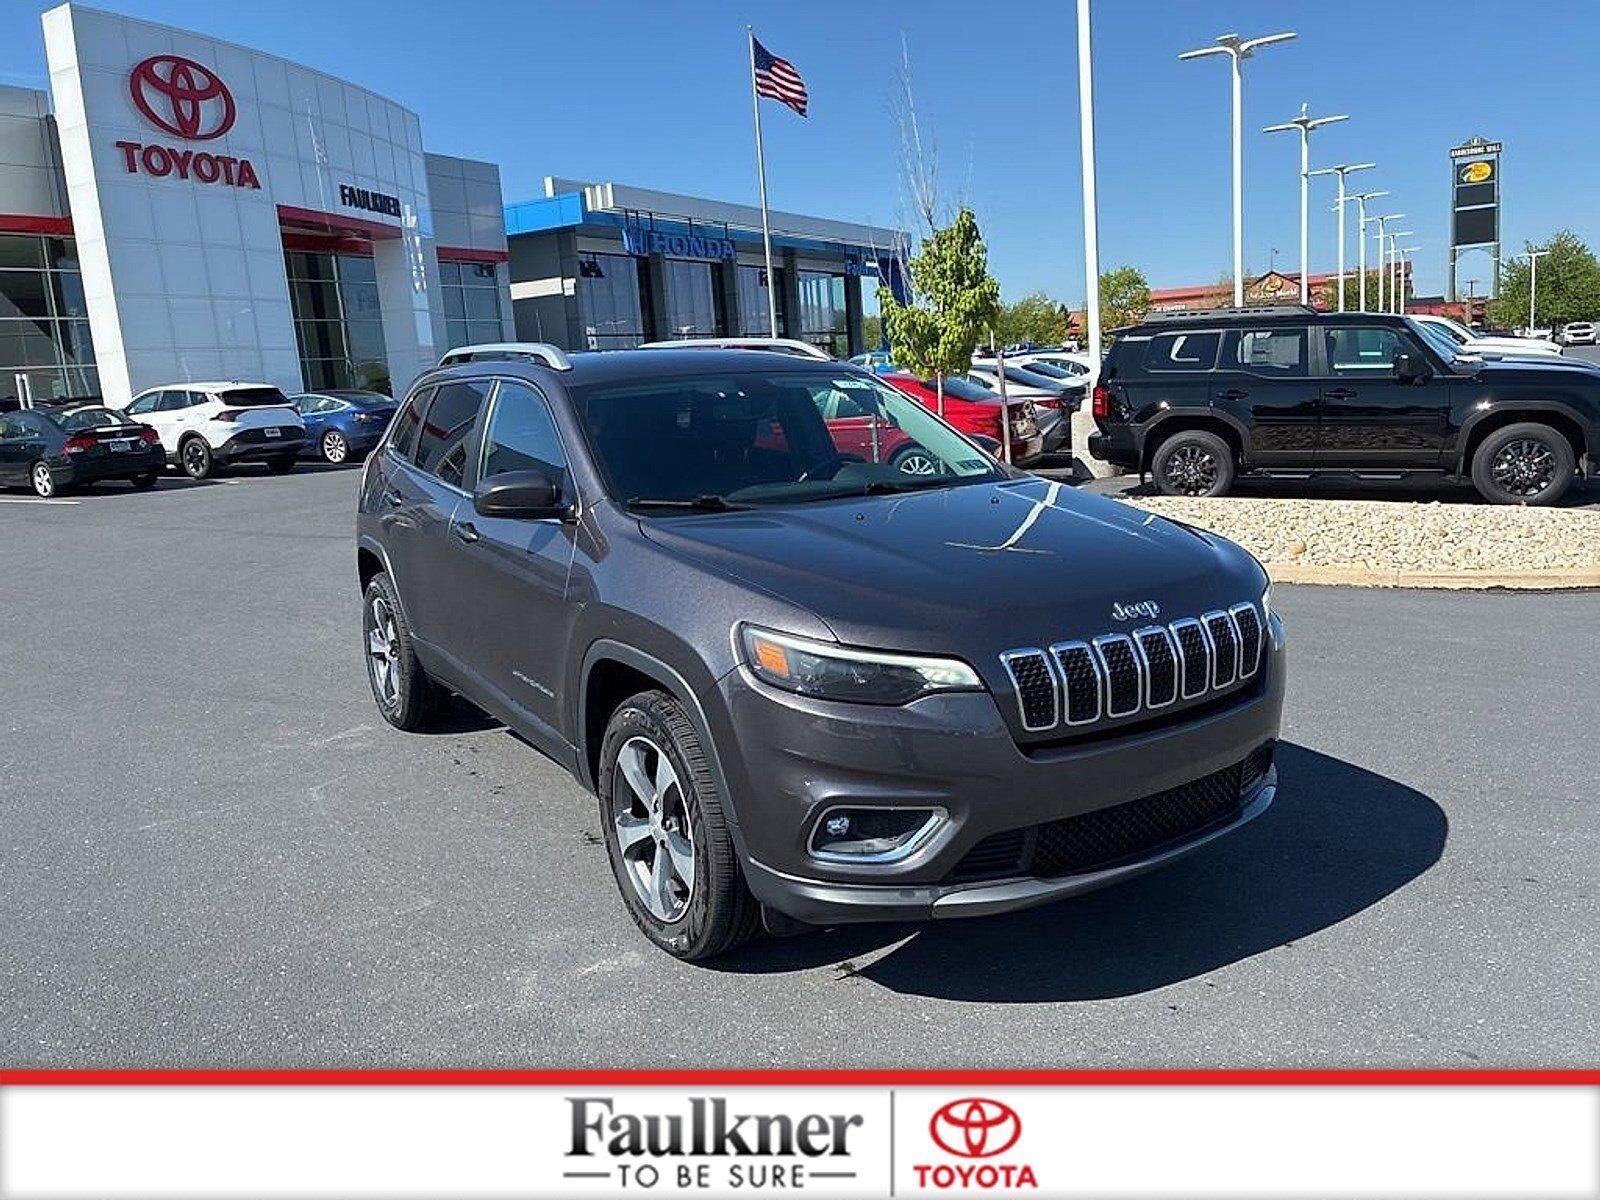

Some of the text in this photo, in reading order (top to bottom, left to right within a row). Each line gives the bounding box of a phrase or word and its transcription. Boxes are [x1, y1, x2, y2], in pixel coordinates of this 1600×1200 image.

[115, 140, 261, 189] TOYOTA
[339, 184, 402, 218] FAULKNER
[649, 233, 738, 260] HONDA
[1112, 600, 1160, 621] Jeep
